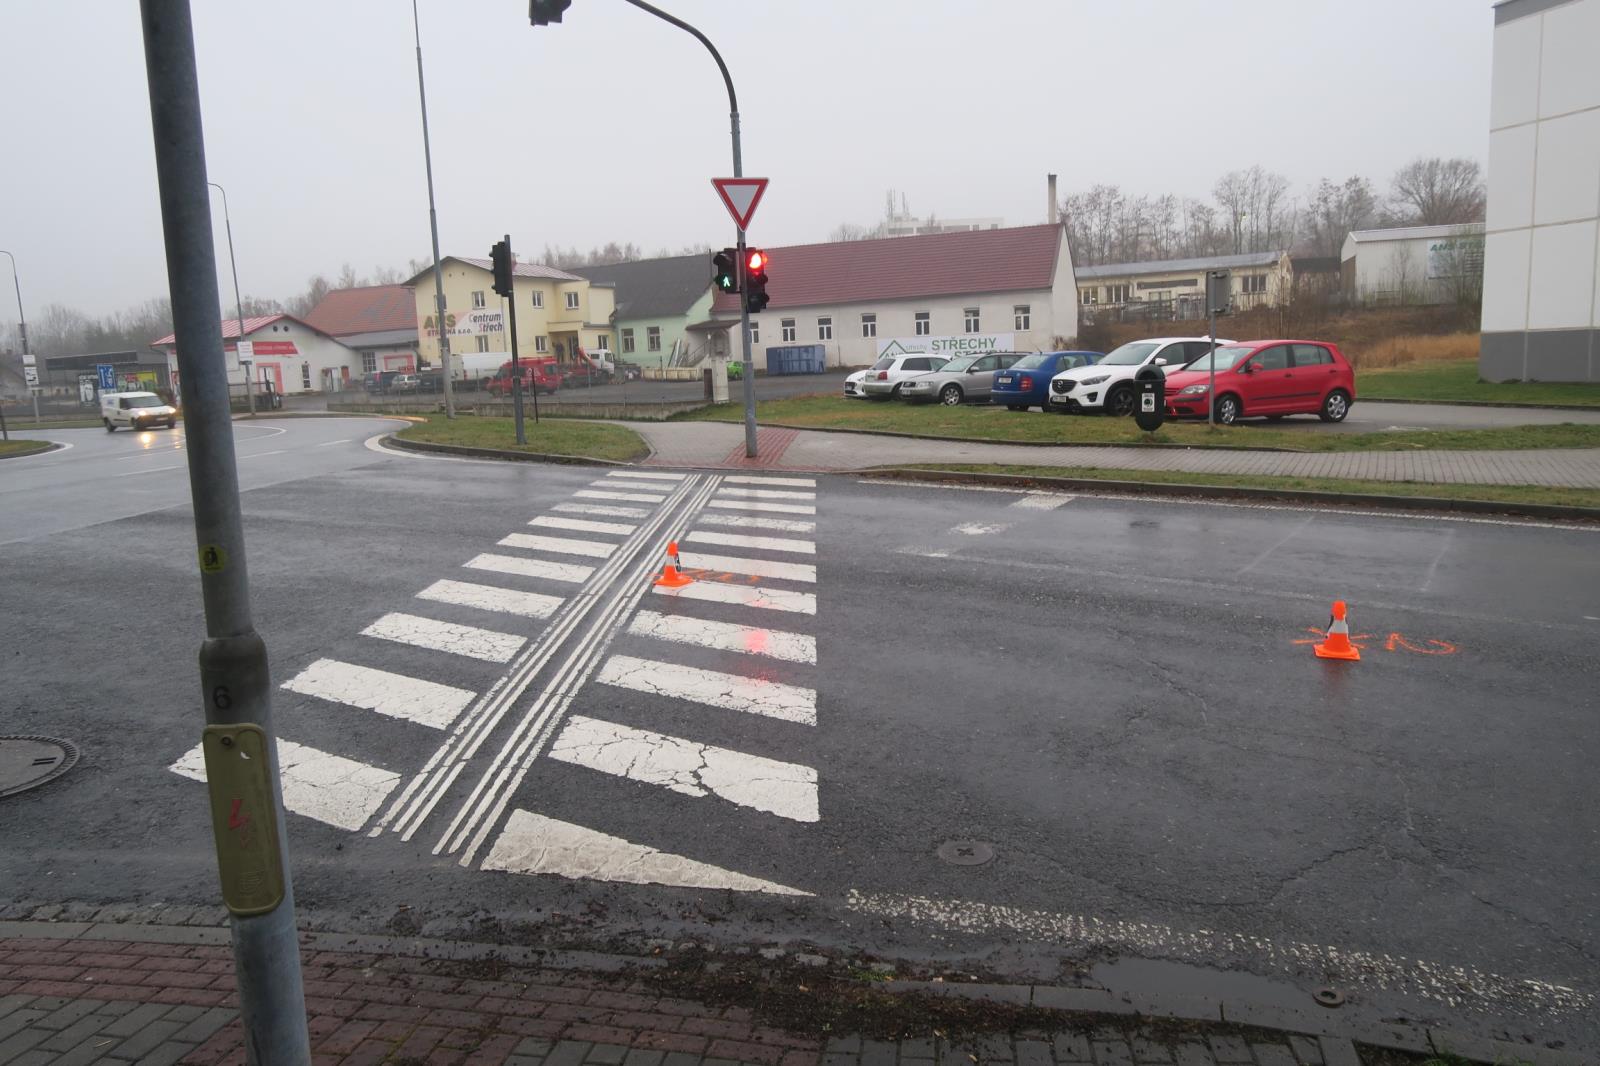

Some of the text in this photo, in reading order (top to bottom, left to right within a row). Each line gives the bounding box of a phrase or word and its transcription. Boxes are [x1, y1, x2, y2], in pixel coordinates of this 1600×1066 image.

[469, 313, 502, 323] Centrum
[932, 337, 996, 351] STŘECHY
[212, 685, 232, 710] 6
